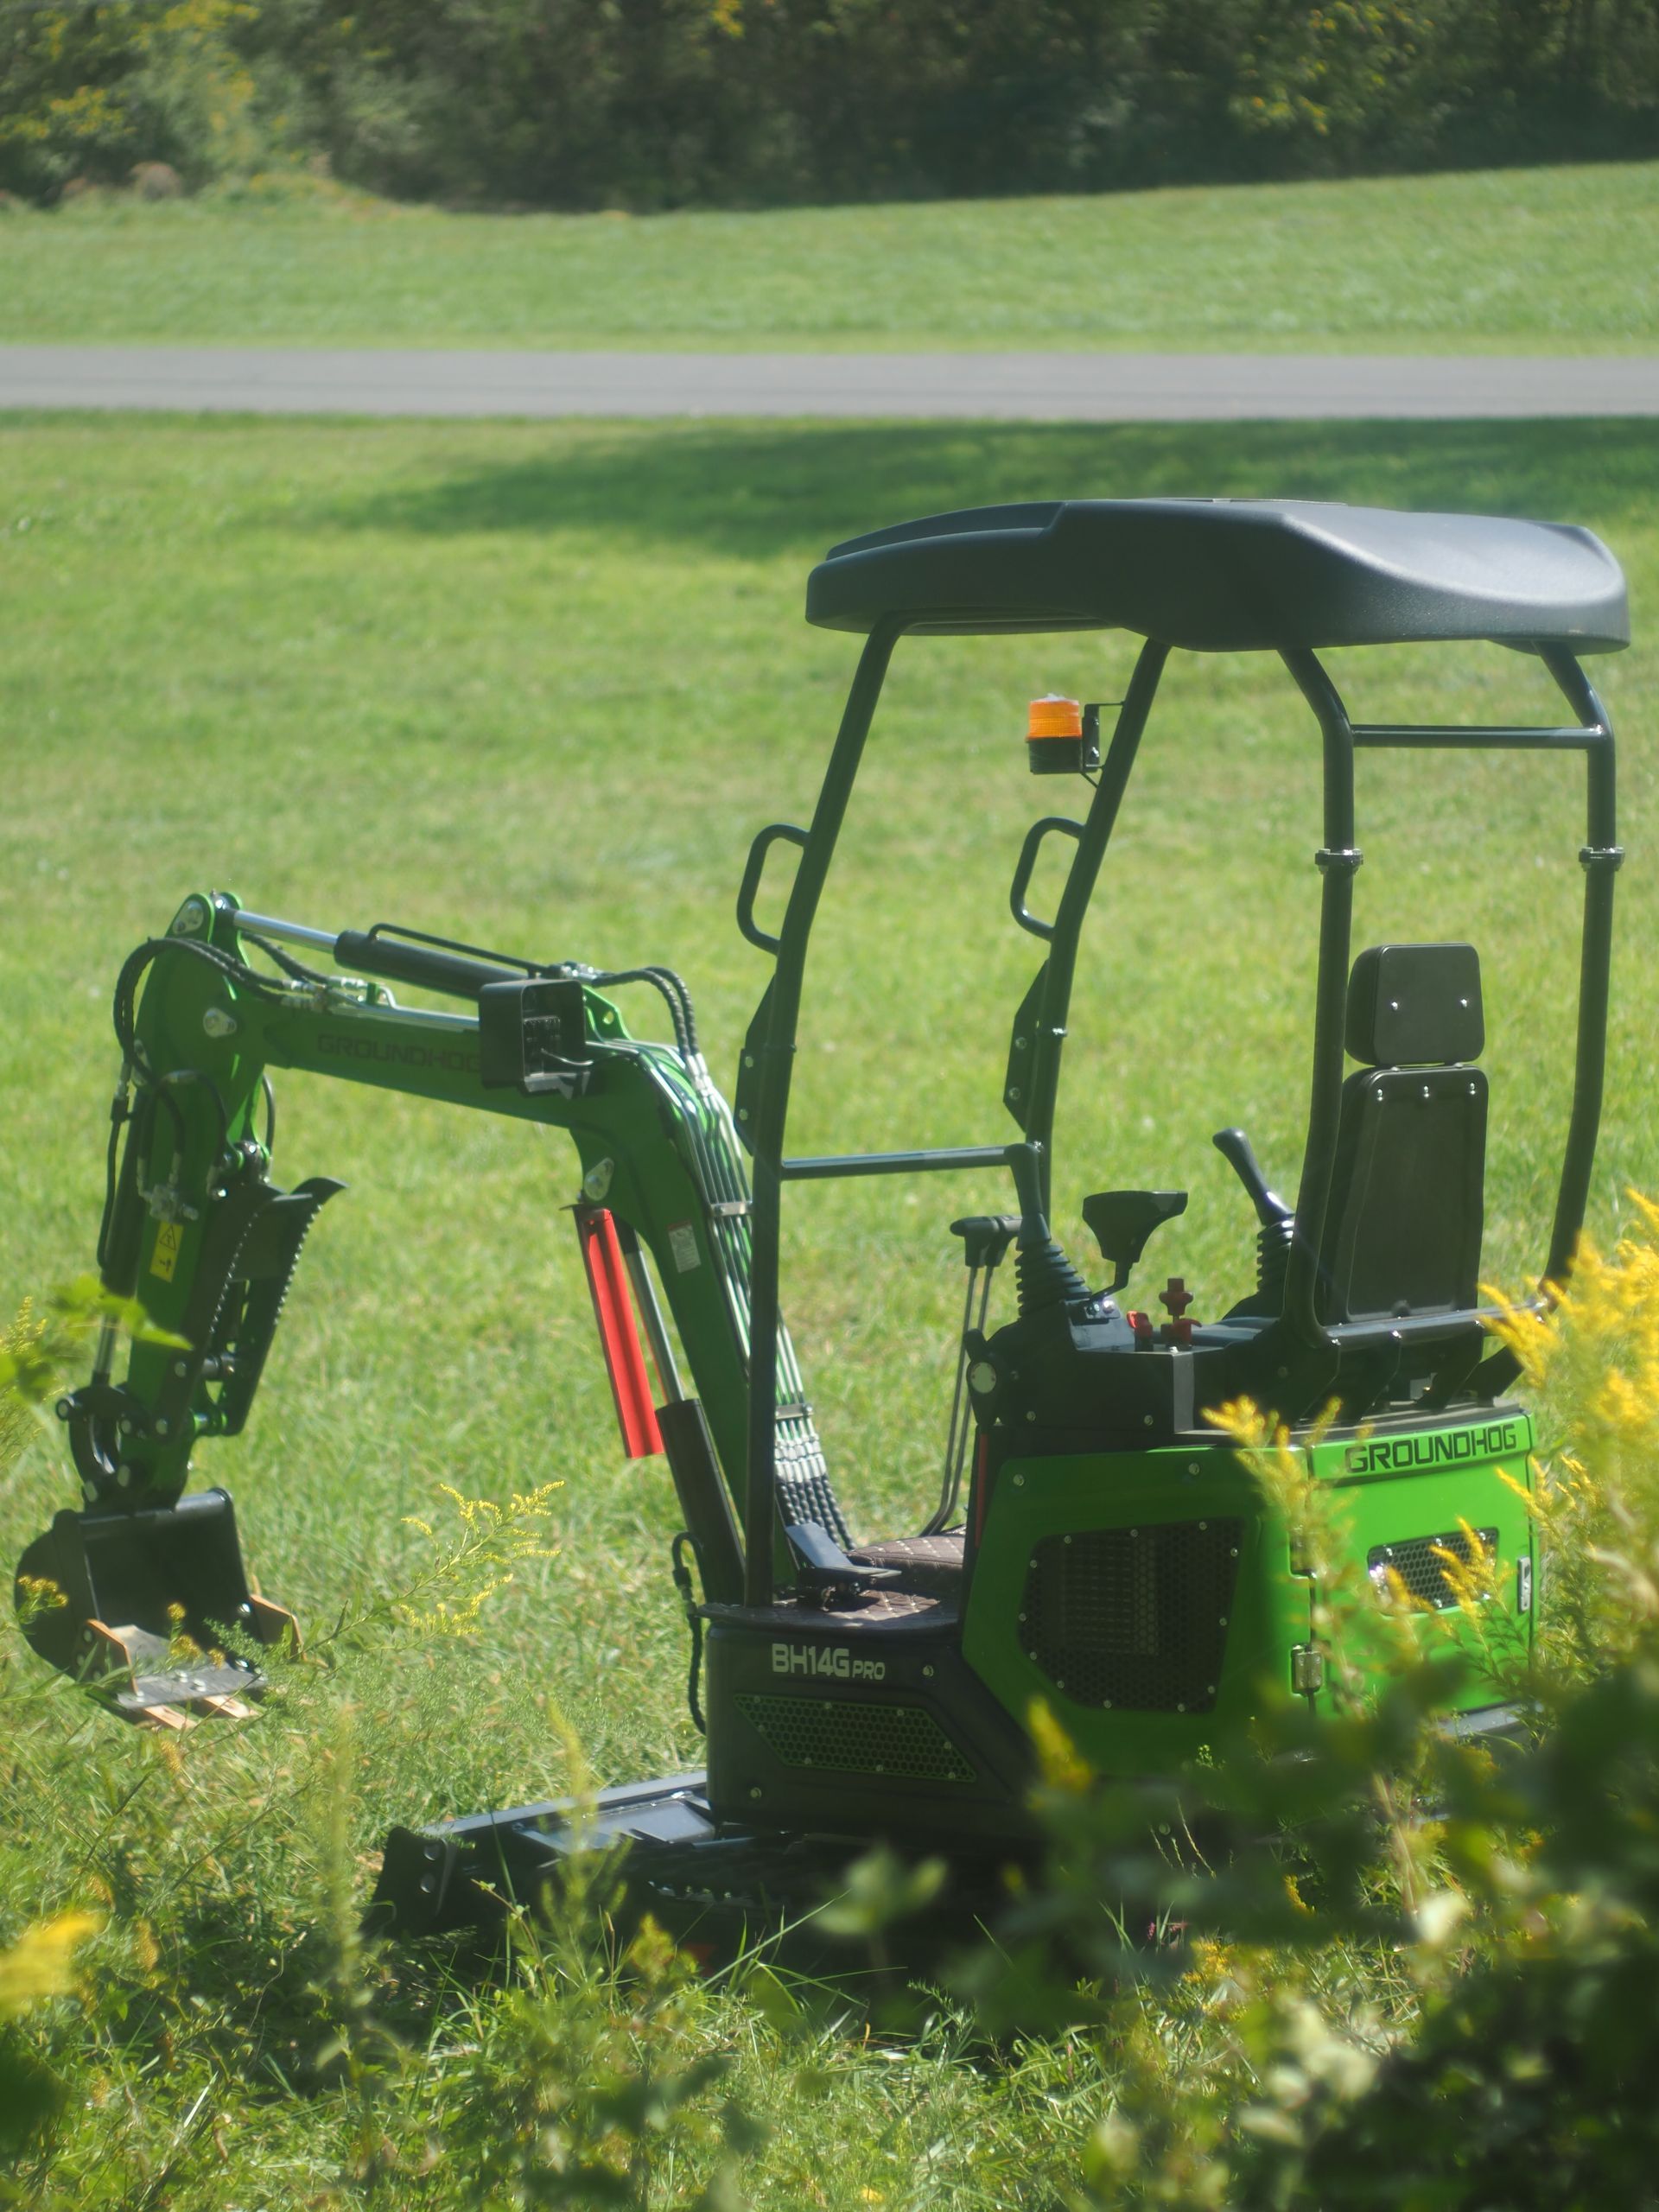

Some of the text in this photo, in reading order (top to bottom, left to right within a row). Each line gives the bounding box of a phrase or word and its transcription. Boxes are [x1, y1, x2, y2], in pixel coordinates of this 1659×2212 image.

[1344, 1423, 1516, 1474] GROUNDHOG
[772, 1643, 886, 1681] BH14G PRO
